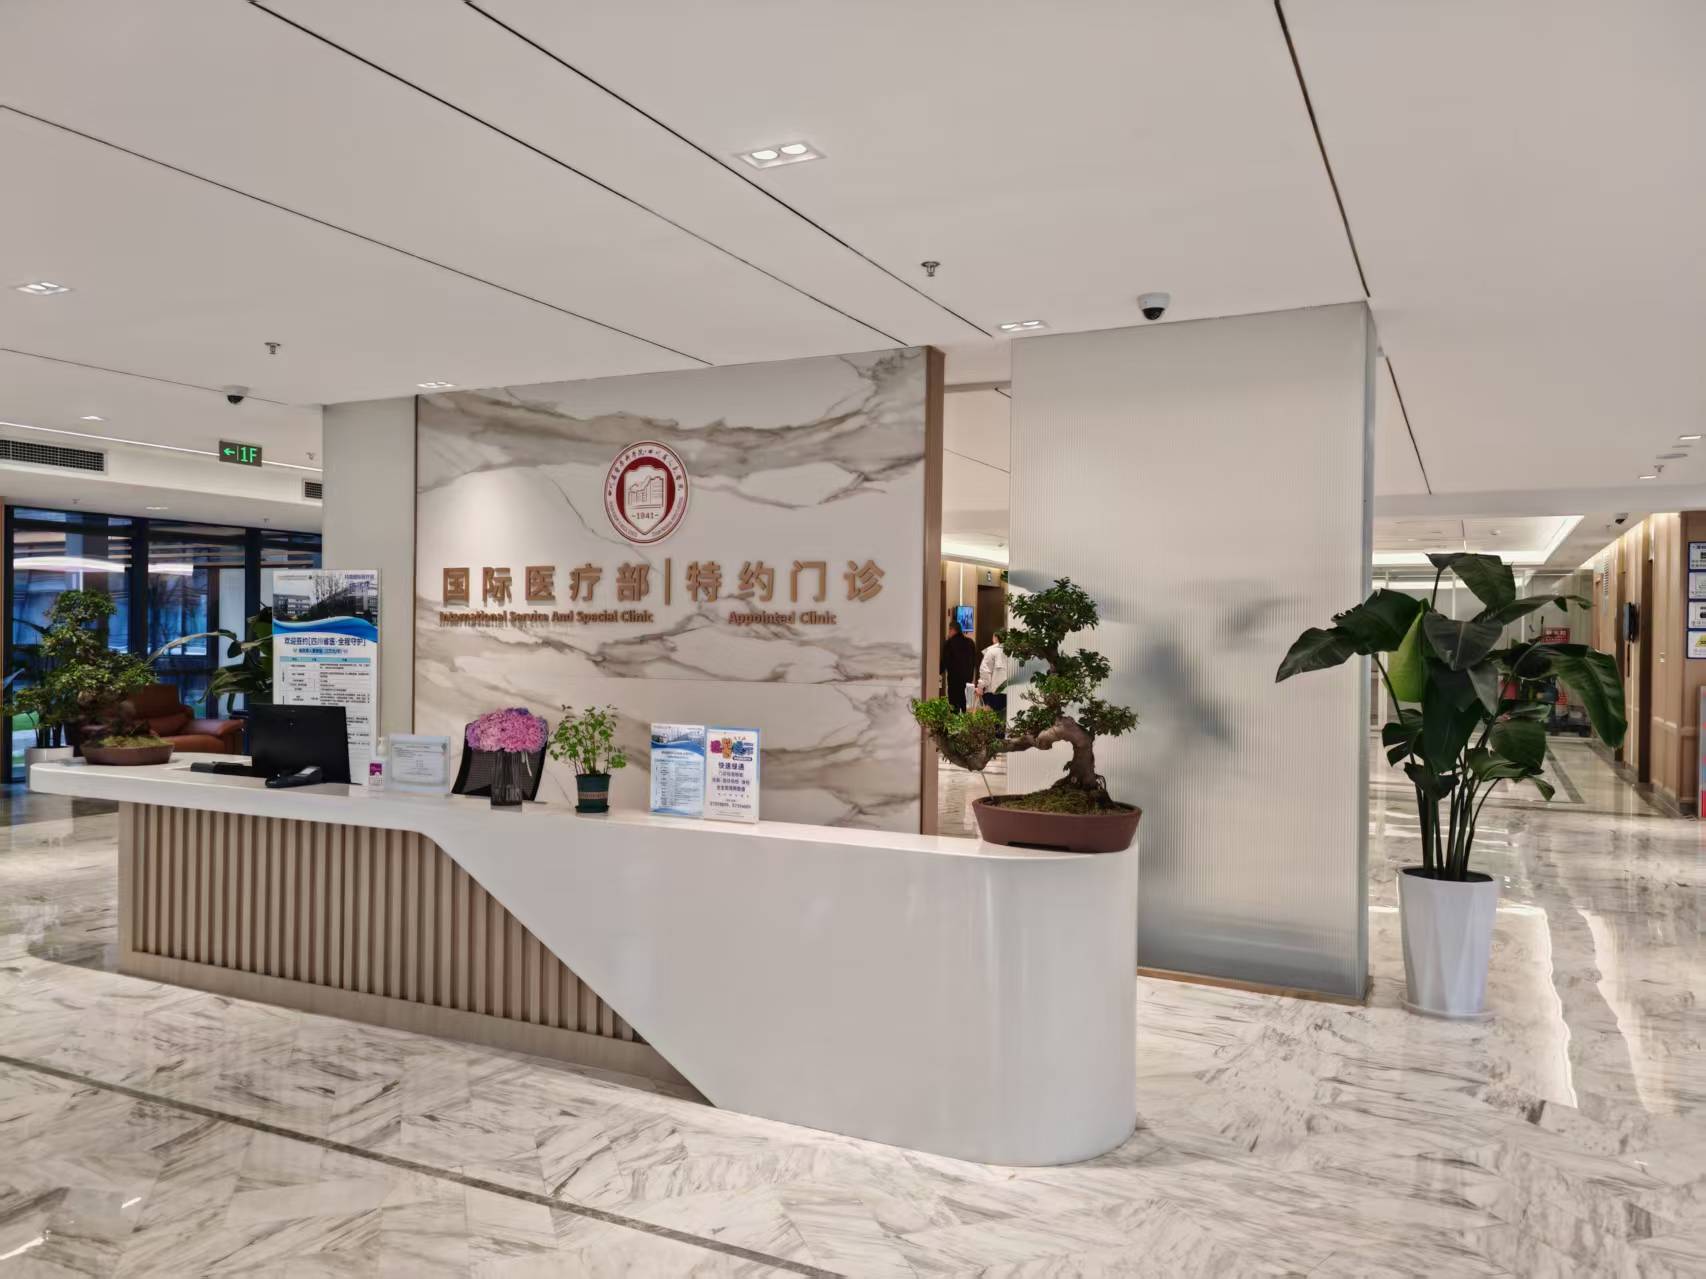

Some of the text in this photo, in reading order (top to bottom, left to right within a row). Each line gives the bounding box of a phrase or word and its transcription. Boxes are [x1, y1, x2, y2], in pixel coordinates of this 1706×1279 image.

[240, 446, 258, 464] 1F
[443, 559, 886, 603] 国际医疗部 特约门诊
[439, 610, 654, 625] International Service And Special Clinic
[728, 610, 837, 626] Appointed Clinic
